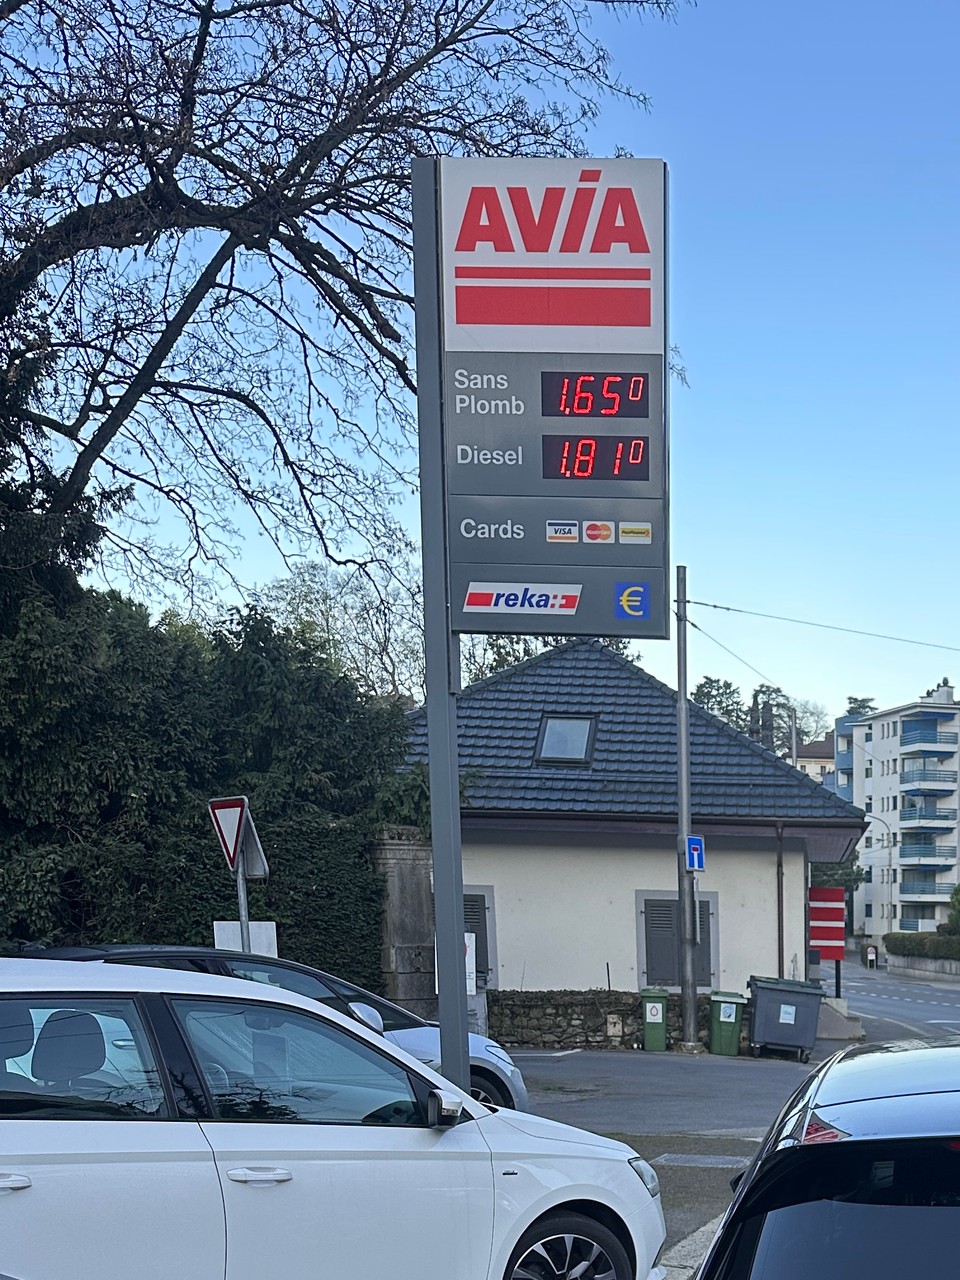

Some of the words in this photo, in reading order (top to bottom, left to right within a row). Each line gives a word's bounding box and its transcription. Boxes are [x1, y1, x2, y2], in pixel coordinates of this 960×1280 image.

[454, 369, 509, 389] Sans
[455, 394, 525, 416] Plomb
[457, 444, 523, 465] Diesel
[460, 518, 525, 539] Cards
